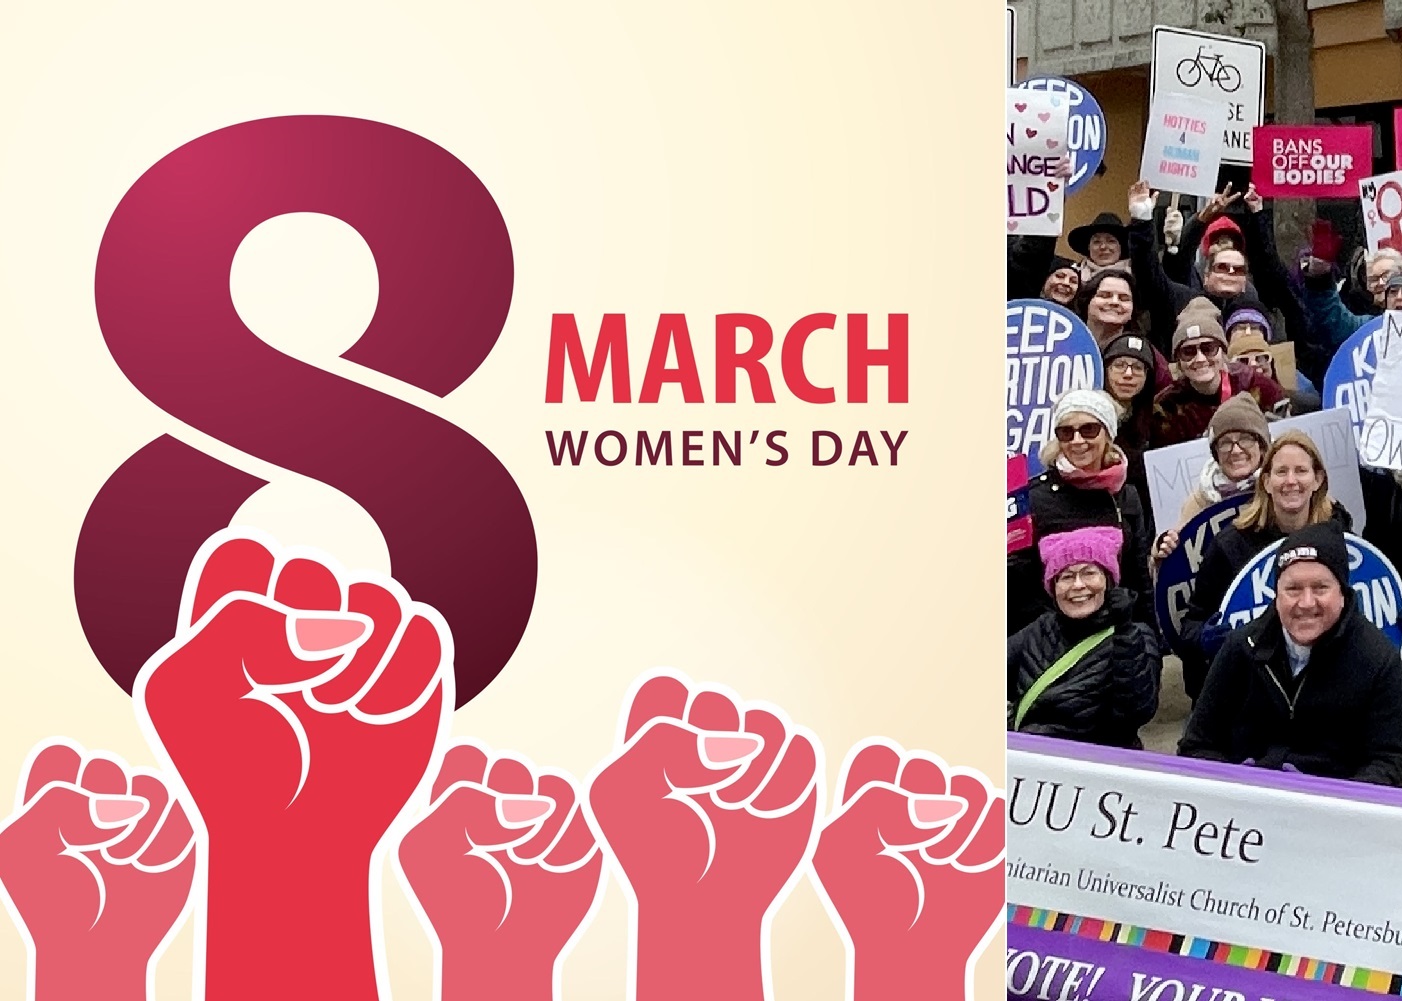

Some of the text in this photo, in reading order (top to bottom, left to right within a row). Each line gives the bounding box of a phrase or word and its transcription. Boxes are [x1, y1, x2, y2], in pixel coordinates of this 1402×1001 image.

[1163, 113, 1207, 135] HOTTIES
[1273, 138, 1323, 154] BANS
[1159, 160, 1197, 178] RIGHTS
[1273, 170, 1346, 185] BODIES
[545, 313, 909, 404] MARCH
[545, 430, 909, 466] WOMEN’S DAY
[1008, 776, 1265, 864] UU St. Pete
[1077, 867, 1186, 908] Universalist
[1190, 888, 1260, 922] Church
[1265, 903, 1287, 926] of
[1290, 905, 1315, 932] St.
